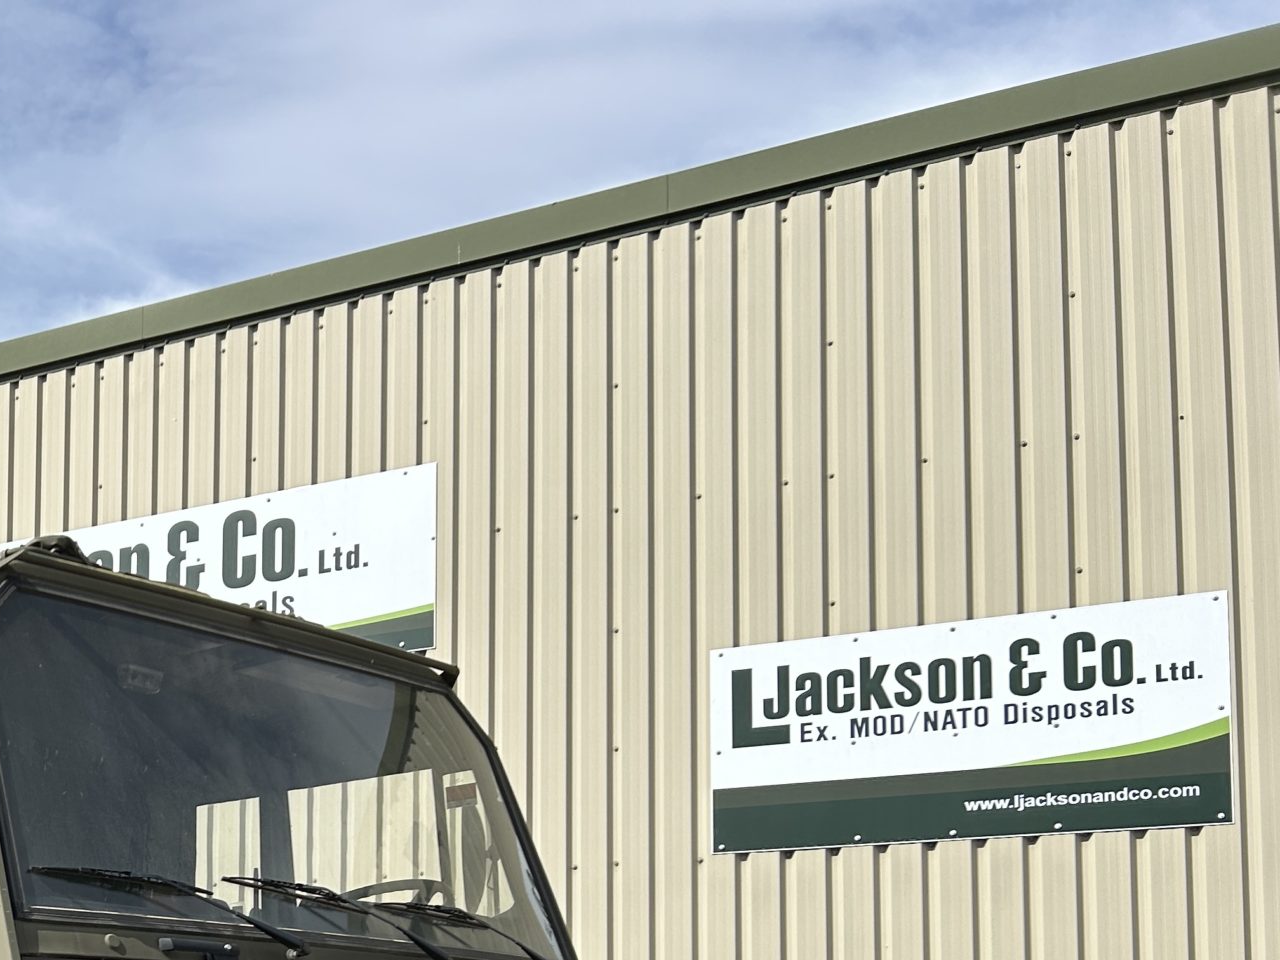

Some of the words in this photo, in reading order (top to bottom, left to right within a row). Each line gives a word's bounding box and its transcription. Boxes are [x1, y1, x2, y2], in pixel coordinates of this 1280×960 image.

[166, 520, 205, 591] &
[222, 509, 308, 589] Co.
[319, 543, 368, 574] Ltd.
[1009, 638, 1047, 696] &
[1063, 631, 1146, 691] Co.
[1155, 661, 1203, 683] Ltd.
[800, 722, 837, 743] Ex.
[850, 705, 989, 738] MOD/NATO
[1004, 693, 1135, 725] Disposals
[963, 785, 1201, 812] www.ljacksonandco.com
